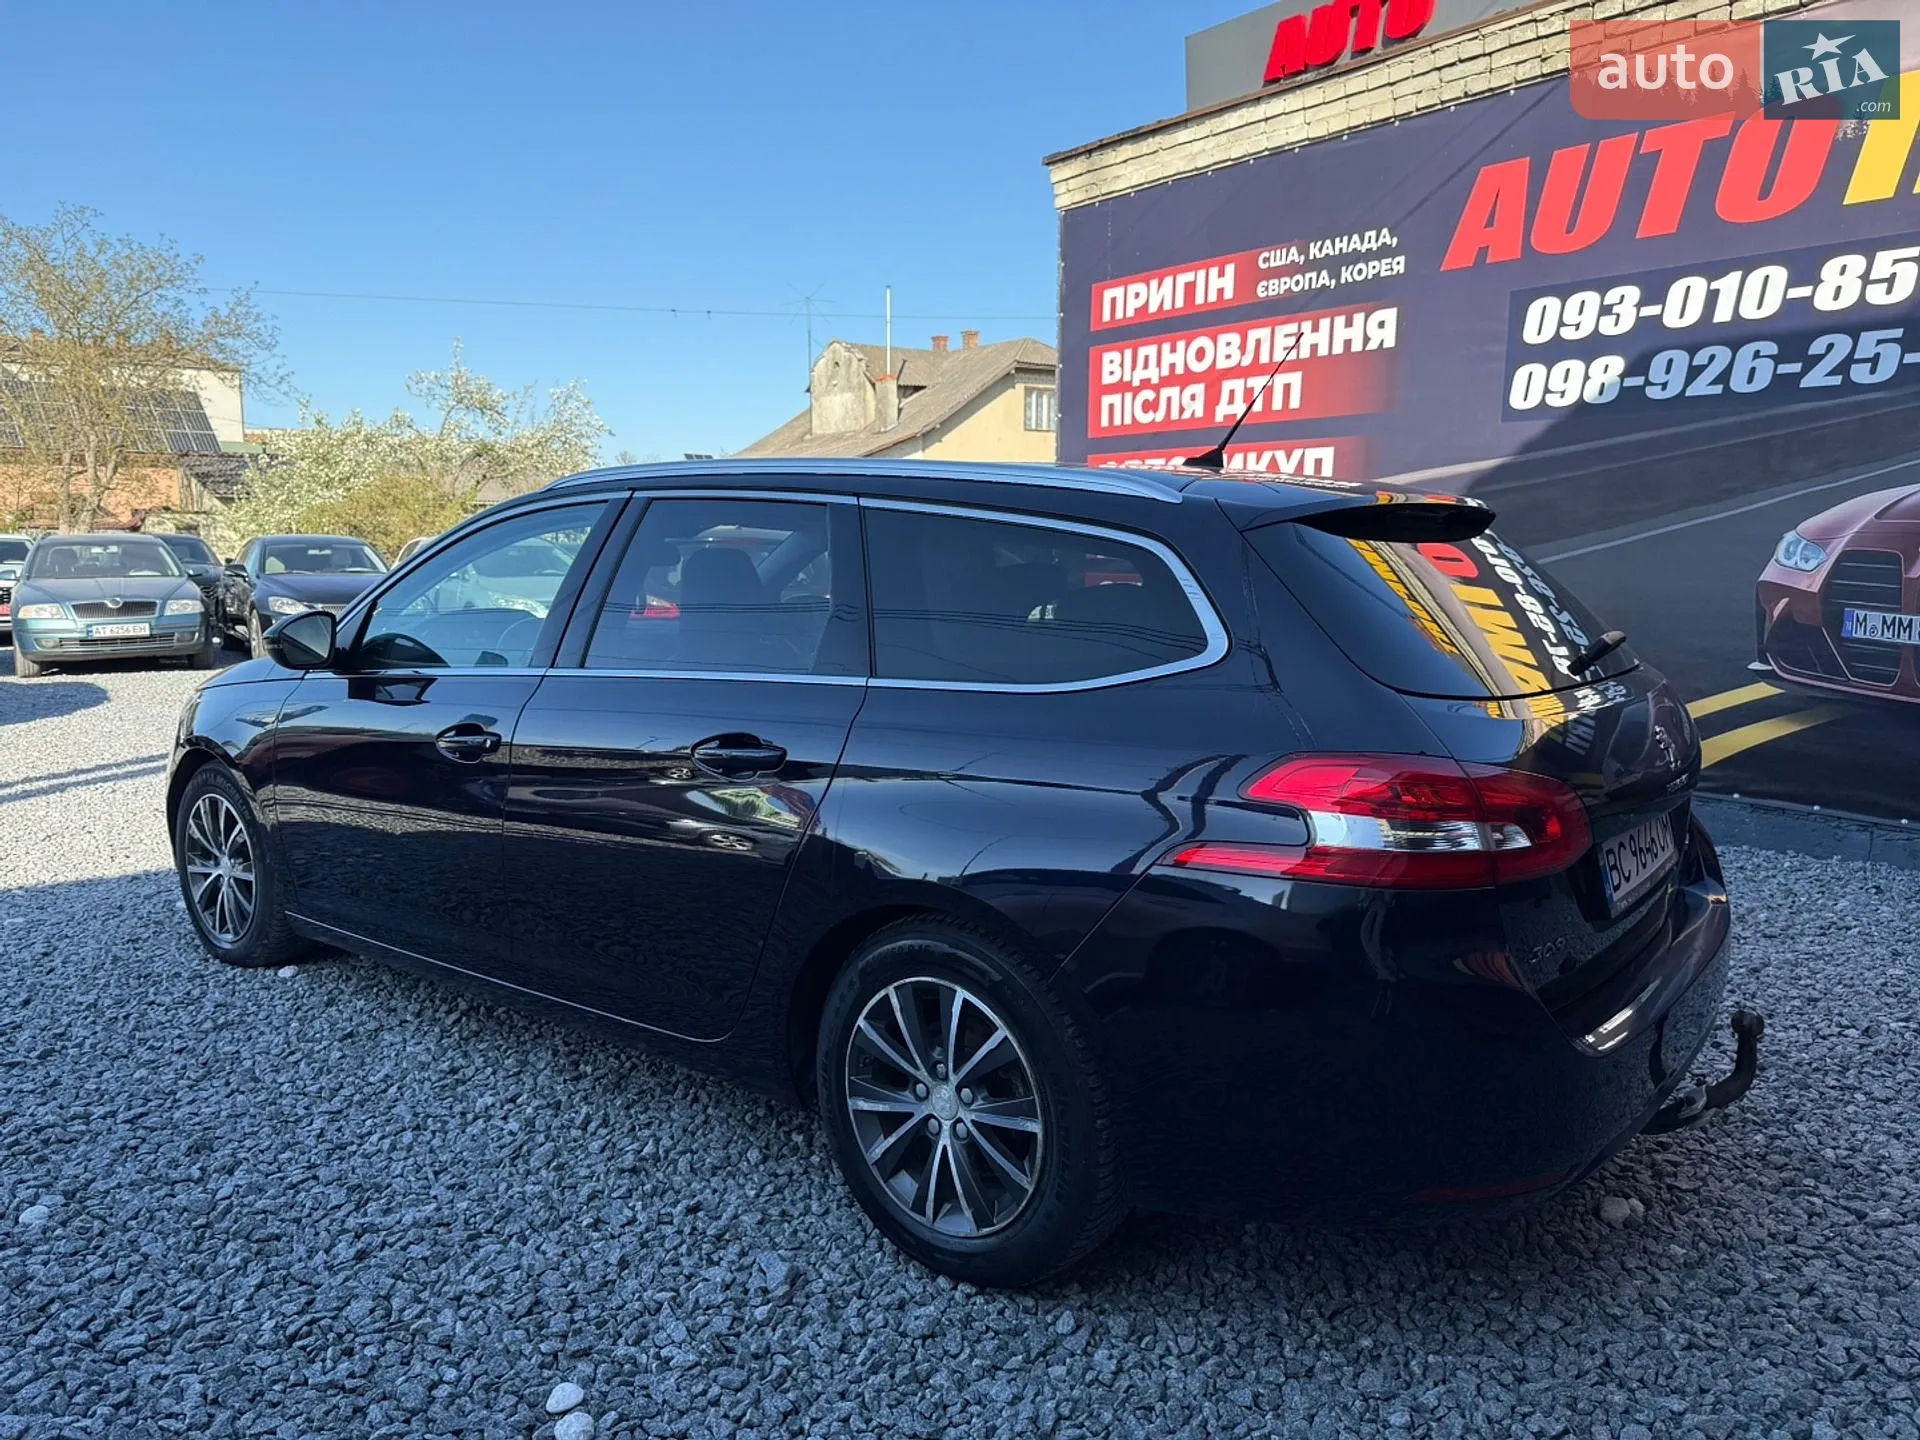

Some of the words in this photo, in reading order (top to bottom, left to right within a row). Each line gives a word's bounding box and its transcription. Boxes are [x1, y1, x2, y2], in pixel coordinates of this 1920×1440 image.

[1264, 0, 1438, 82] AUTO
[1440, 93, 1842, 272] AUTO
[1256, 269, 1336, 298] ЄВРОПА,
[1340, 255, 1405, 284] КОРЕЯ
[1257, 242, 1306, 270] США,
[1309, 226, 1399, 259] КАНАДА,
[1101, 262, 1236, 323] ПРИГІН
[1101, 307, 1398, 387] ВІДНОВЛЕННЯ
[1101, 383, 1205, 427] ПІСЛЯ
[1215, 371, 1303, 422] ДТП
[1605, 840, 1632, 894] BC
